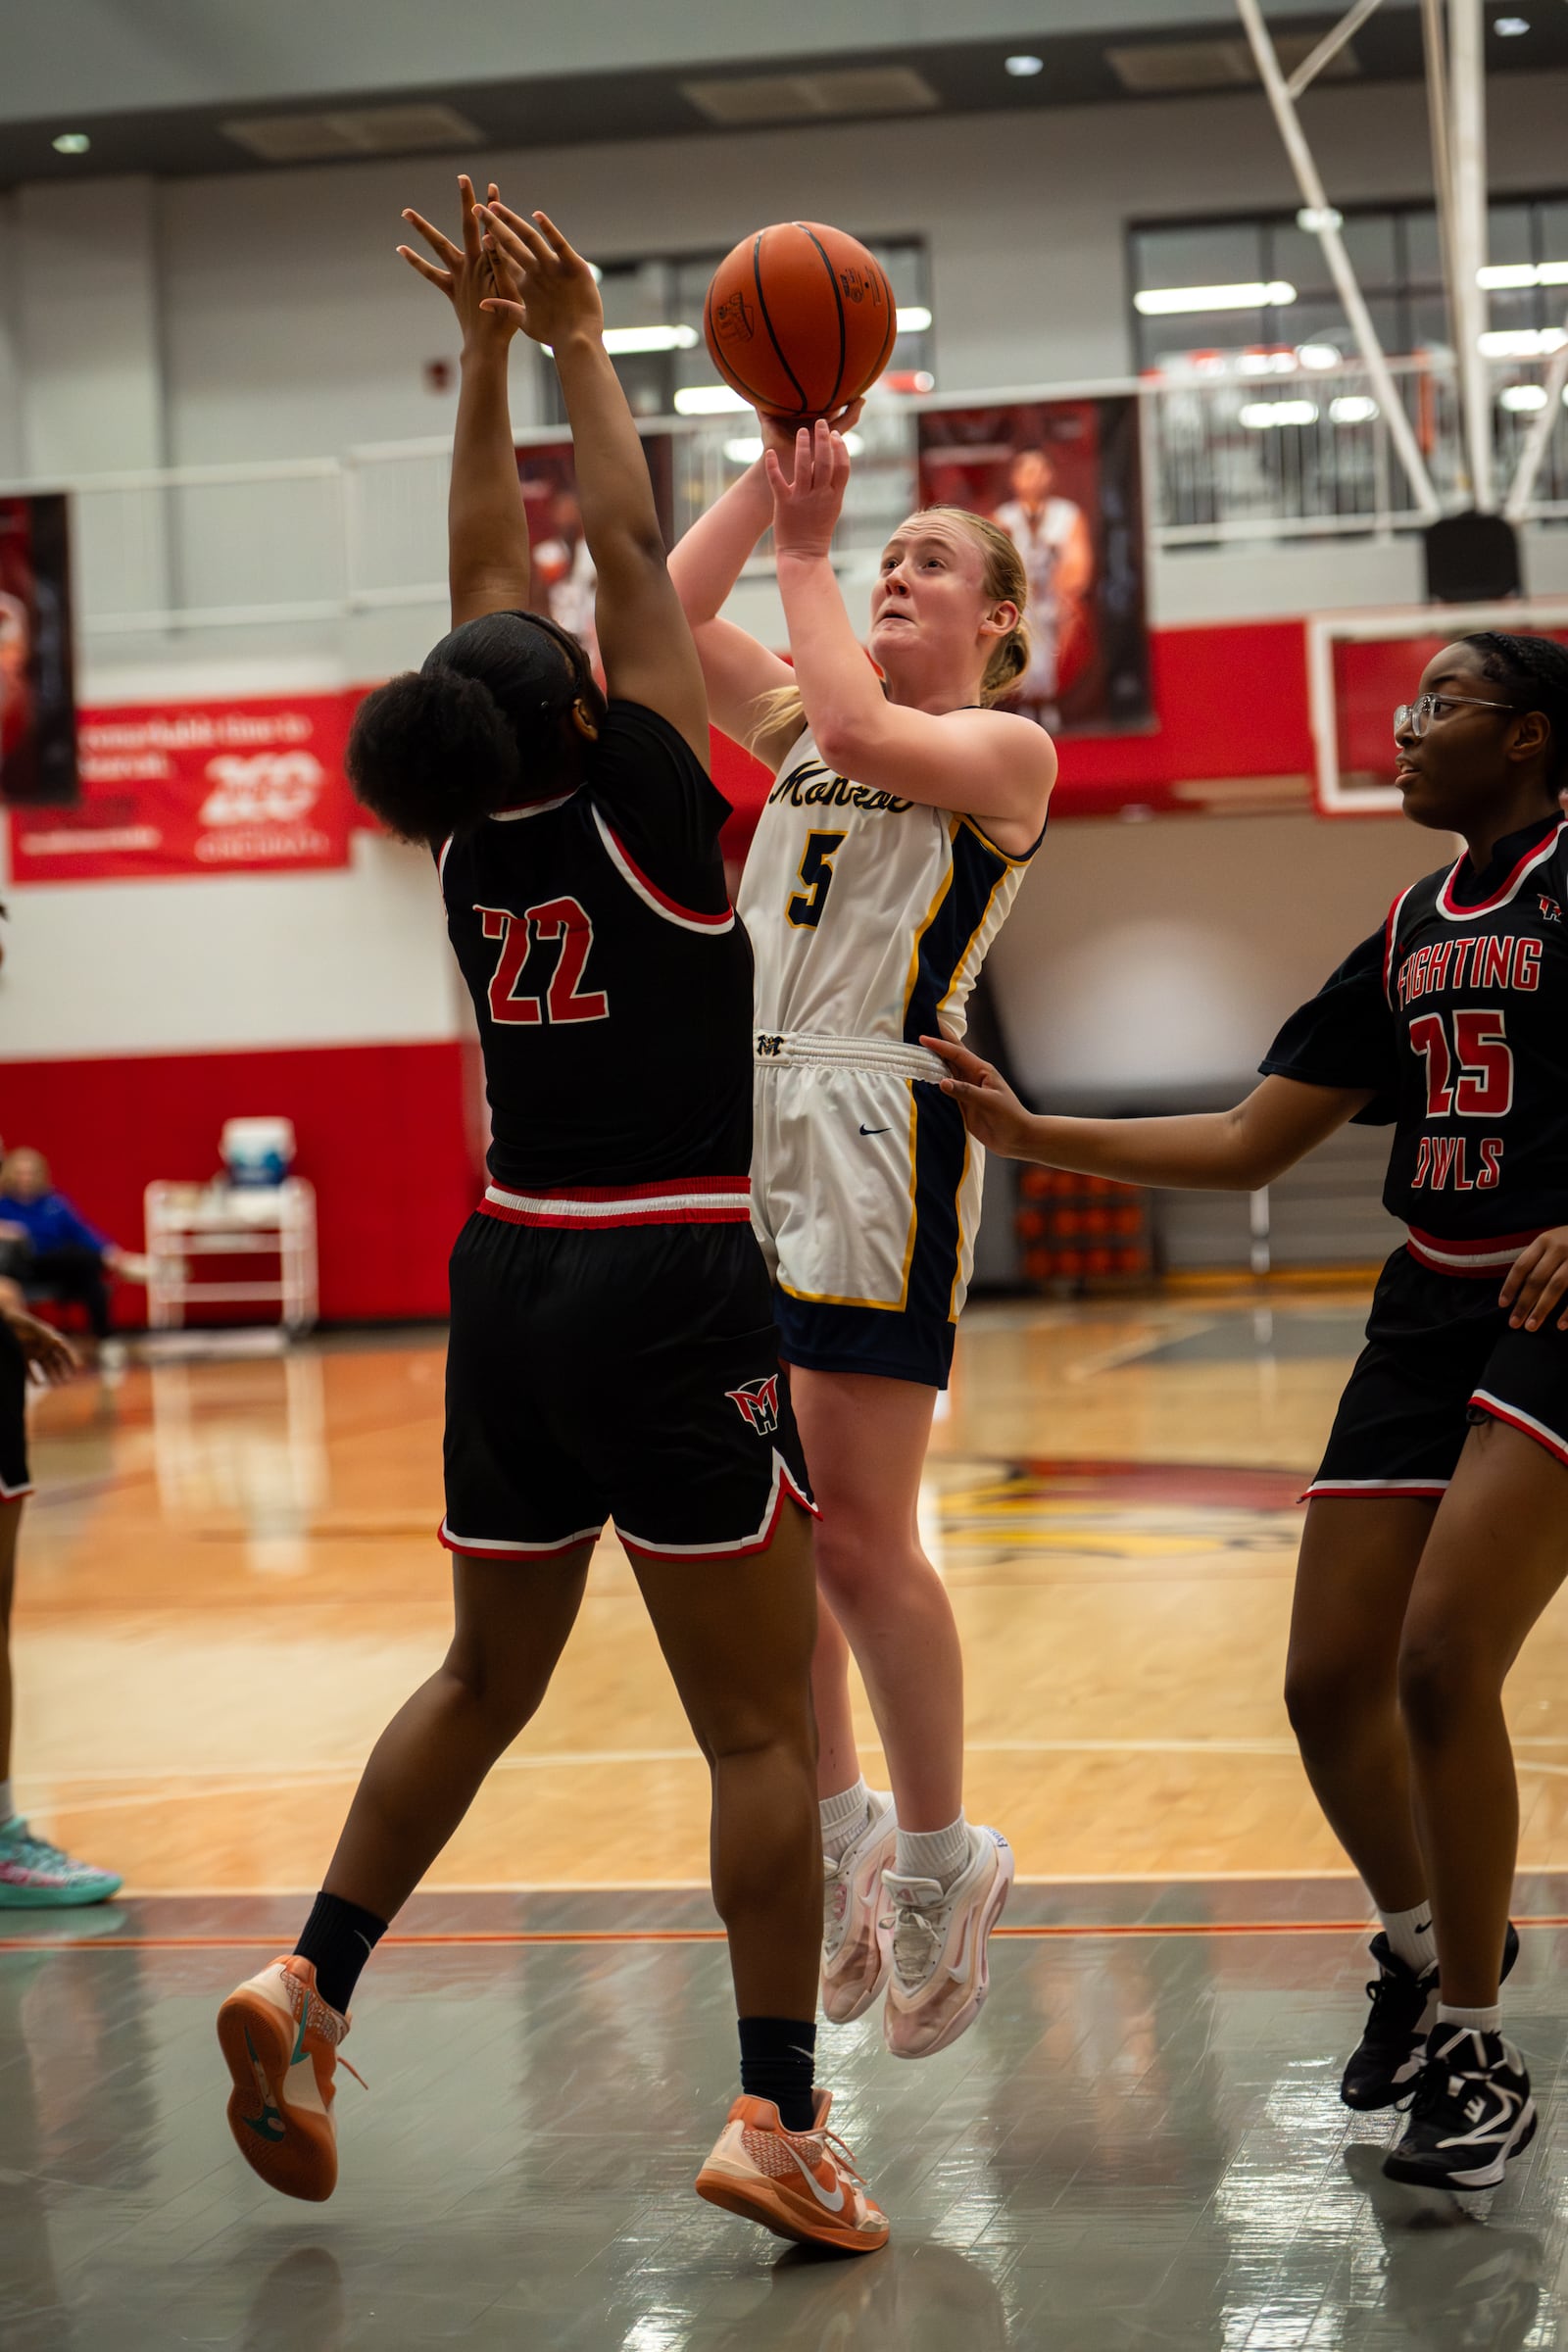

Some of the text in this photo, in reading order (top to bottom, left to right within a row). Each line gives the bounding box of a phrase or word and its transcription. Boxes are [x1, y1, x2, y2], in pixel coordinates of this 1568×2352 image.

[785, 828, 849, 931] 5
[471, 895, 611, 1025] 22
[1396, 935, 1544, 1011] FIGHTING
[1411, 1137, 1504, 1191] OWLS
